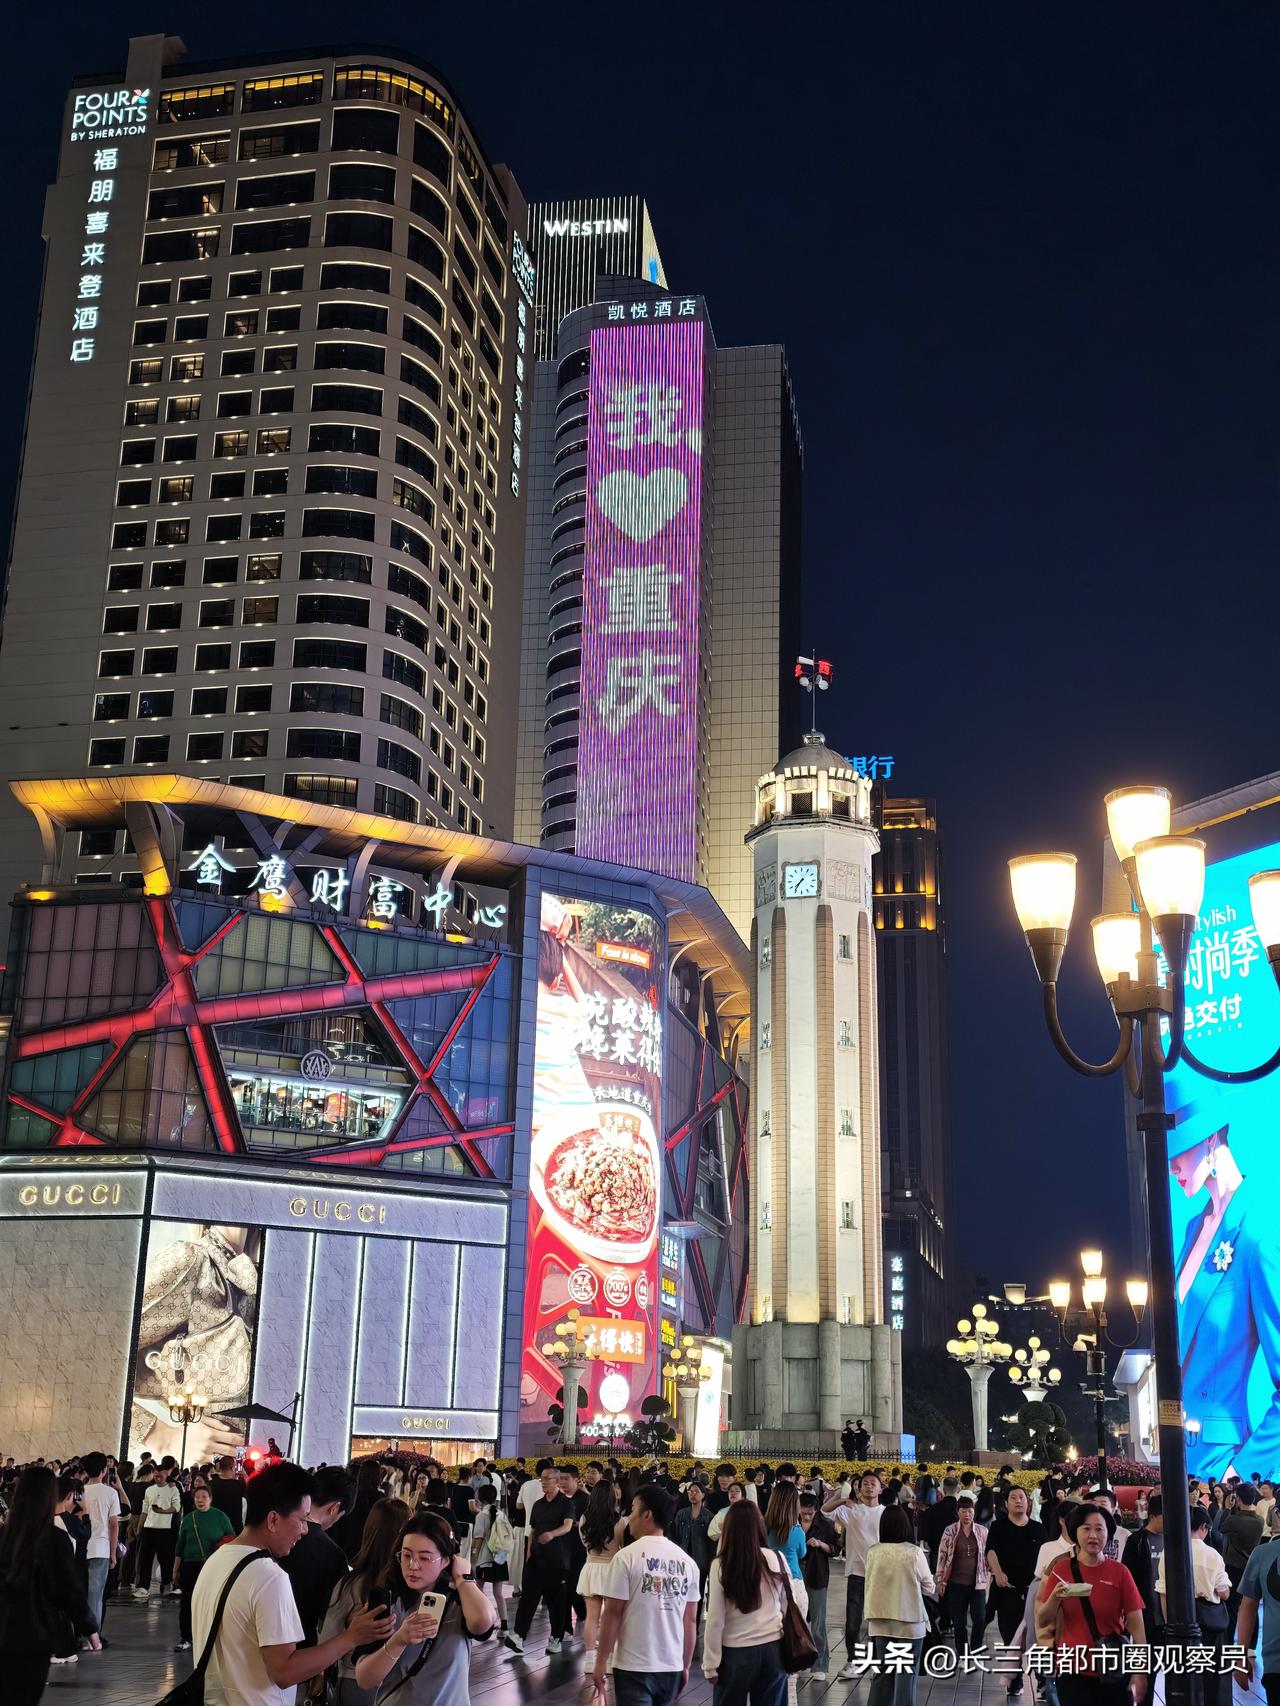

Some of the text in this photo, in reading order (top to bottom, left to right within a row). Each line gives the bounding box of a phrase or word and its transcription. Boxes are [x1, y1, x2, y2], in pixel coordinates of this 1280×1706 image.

[75, 90, 130, 112] FOUR
[72, 106, 148, 130] POINTS
[70, 125, 146, 142] BY SHERATON
[69, 147, 119, 362] 福朋喜来登酒店
[608, 298, 697, 321] 凯悦酒店
[188, 842, 507, 929] 金鹰财富中心
[1194, 904, 1237, 933] tylish
[19, 1184, 121, 1206] GUCCI
[288, 1197, 386, 1224] GUCCI
